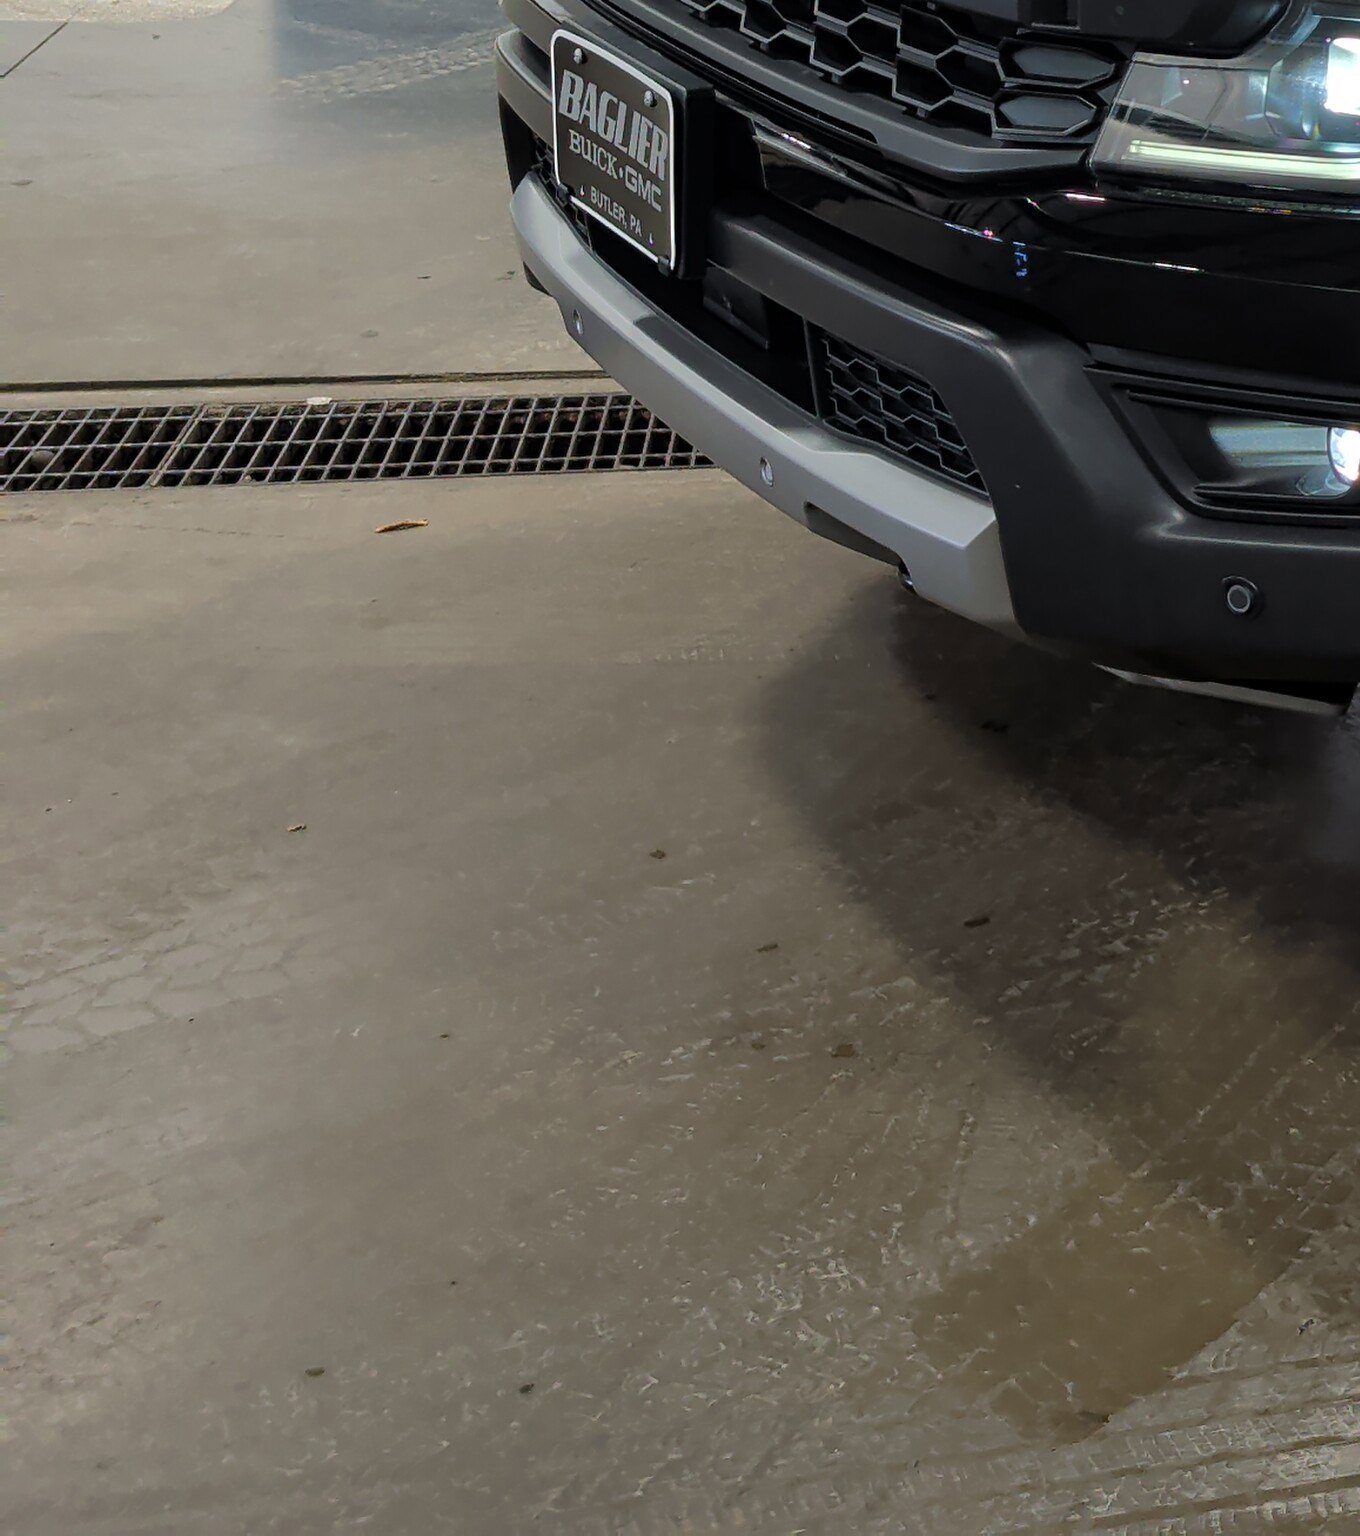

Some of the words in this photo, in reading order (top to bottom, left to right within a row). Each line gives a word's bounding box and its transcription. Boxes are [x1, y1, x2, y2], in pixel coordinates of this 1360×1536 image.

[558, 69, 669, 182] BAGLIER
[568, 129, 618, 180] BUICK
[624, 165, 663, 213] GMC
[590, 185, 628, 230] BUTLER,
[630, 214, 642, 237] PA
